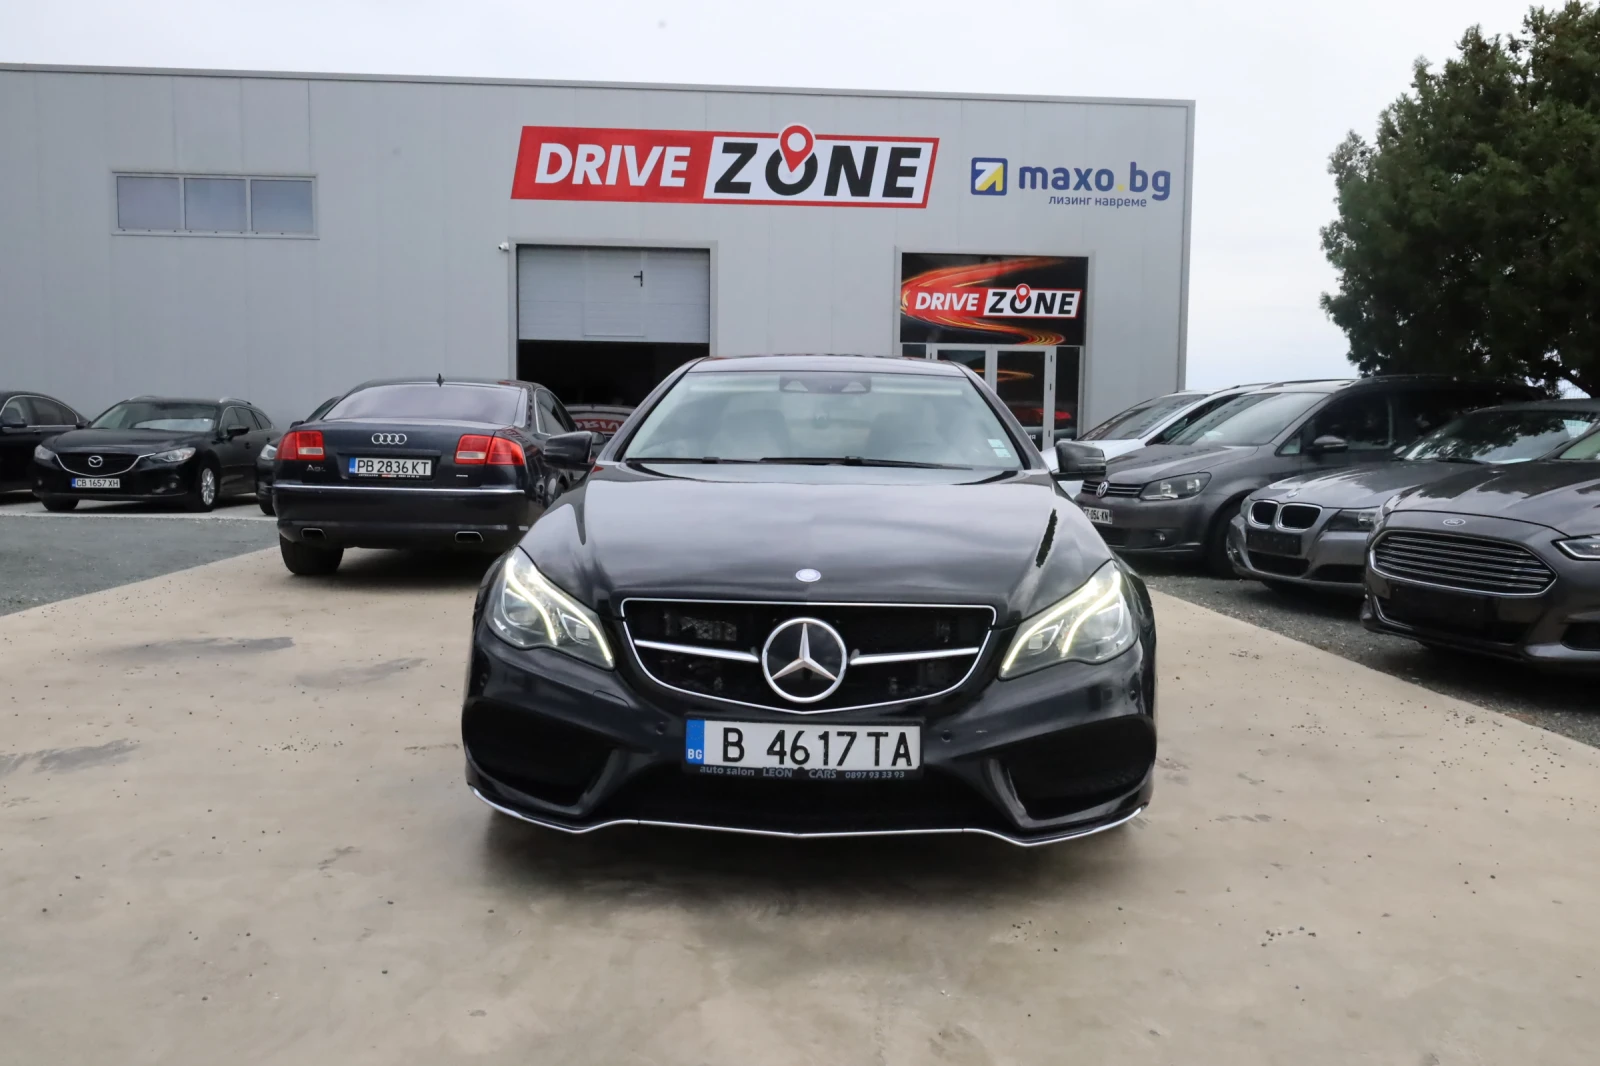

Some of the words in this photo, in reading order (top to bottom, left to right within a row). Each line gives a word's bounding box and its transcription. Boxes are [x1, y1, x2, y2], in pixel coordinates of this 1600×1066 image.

[535, 142, 691, 188] DRIVE
[714, 142, 922, 199] ZONE
[1018, 161, 1171, 202] maxo.bg
[1048, 195, 1092, 206] лизинг
[1094, 197, 1147, 209] навреме
[915, 292, 980, 311] DRIVE
[988, 291, 1075, 315] ZONE
[357, 459, 374, 473] PB
[377, 460, 409, 474] 2836
[411, 461, 429, 475] KT
[76, 479, 87, 487] CB
[89, 479, 107, 487] 1657
[108, 479, 119, 487] XH
[687, 748, 703, 760] BG
[722, 727, 745, 763] B
[766, 729, 858, 766] 4617
[866, 731, 913, 767] TA
[699, 766, 724, 774] auto
[726, 767, 755, 776] salon
[763, 767, 793, 778] LEON
[808, 769, 837, 779] CARS
[845, 771, 867, 779] 0897
[869, 771, 880, 779] 93
[881, 771, 892, 779] 33
[894, 770, 905, 778] 93
